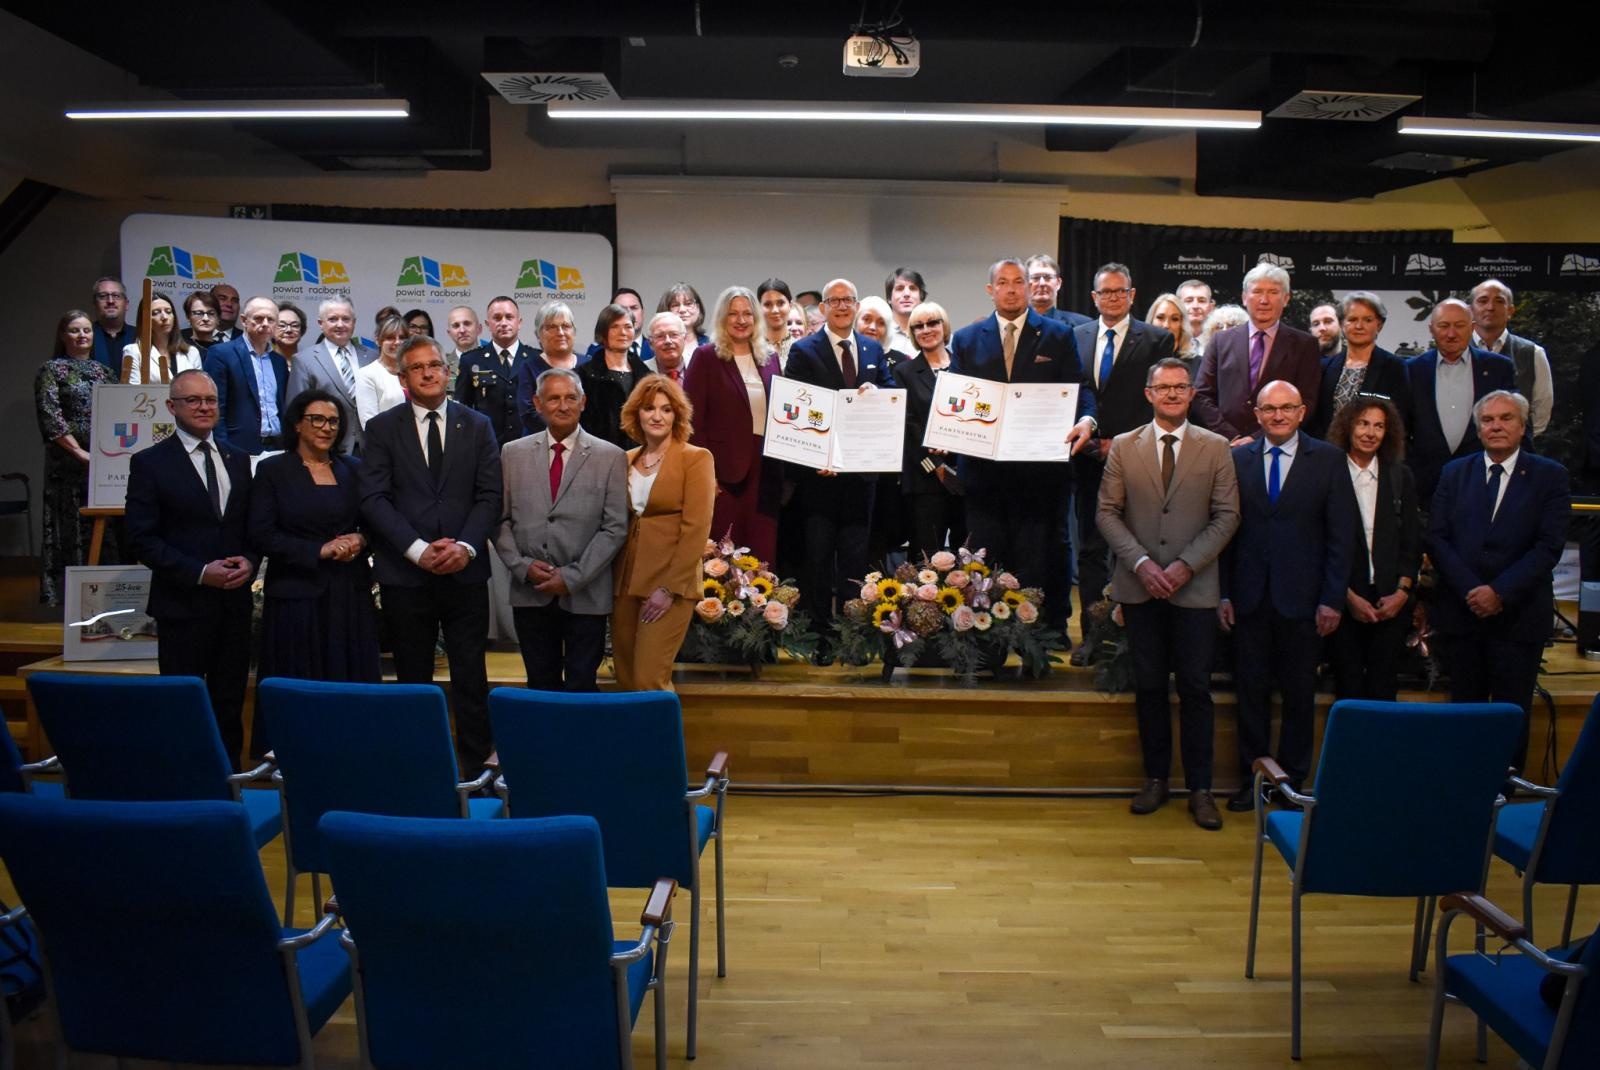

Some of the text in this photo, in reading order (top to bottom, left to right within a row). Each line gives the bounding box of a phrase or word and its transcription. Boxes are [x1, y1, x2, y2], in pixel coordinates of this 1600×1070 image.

[151, 280, 176, 289] owiat
[273, 286, 351, 295] powiat raciborski
[396, 288, 471, 297] powiat raciborski
[514, 291, 586, 300] powiat raciborski
[963, 382, 982, 399] 25
[795, 387, 813, 406] 25
[132, 392, 157, 419] 25
